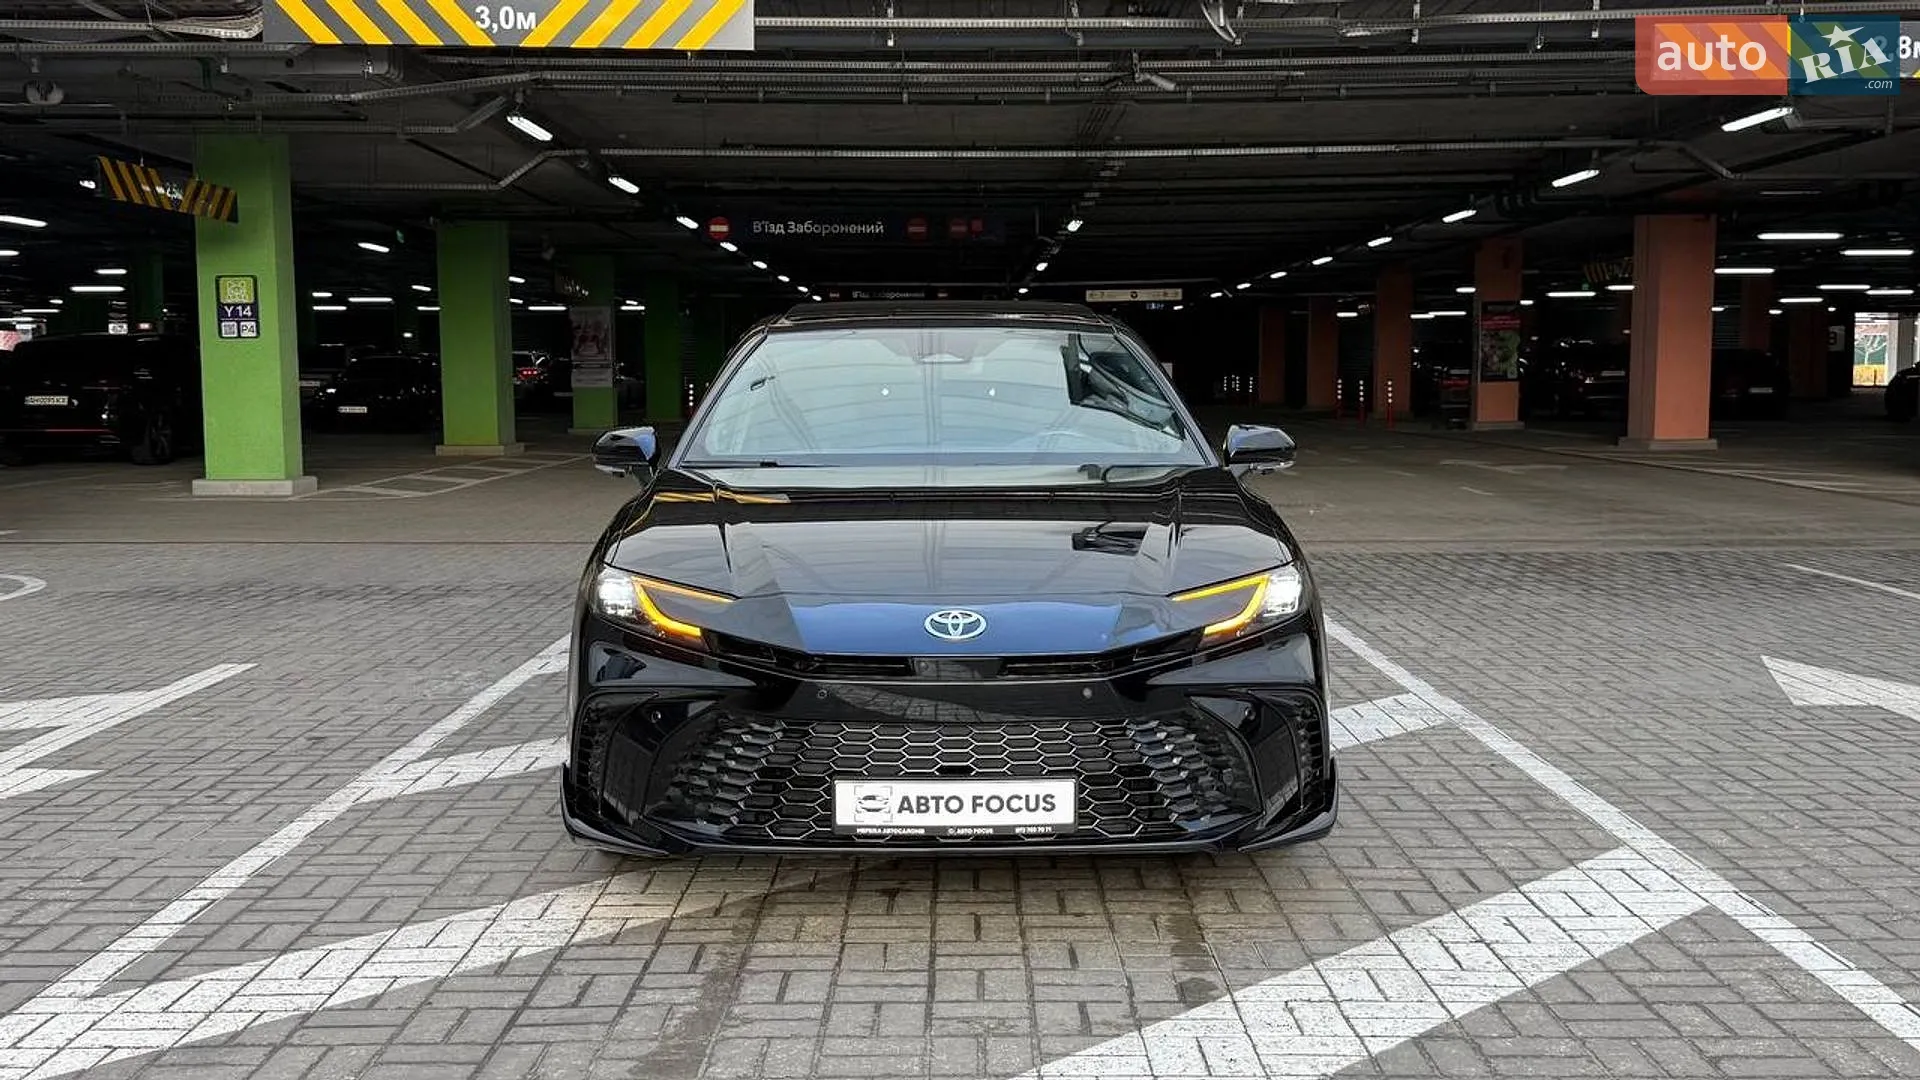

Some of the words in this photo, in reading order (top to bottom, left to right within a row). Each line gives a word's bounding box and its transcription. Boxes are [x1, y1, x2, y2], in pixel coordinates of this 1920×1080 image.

[475, 5, 537, 33] 3,0м
[787, 220, 885, 236] Заборонений
[897, 795, 964, 814] АВТО
[971, 793, 1057, 814] FOCUS
